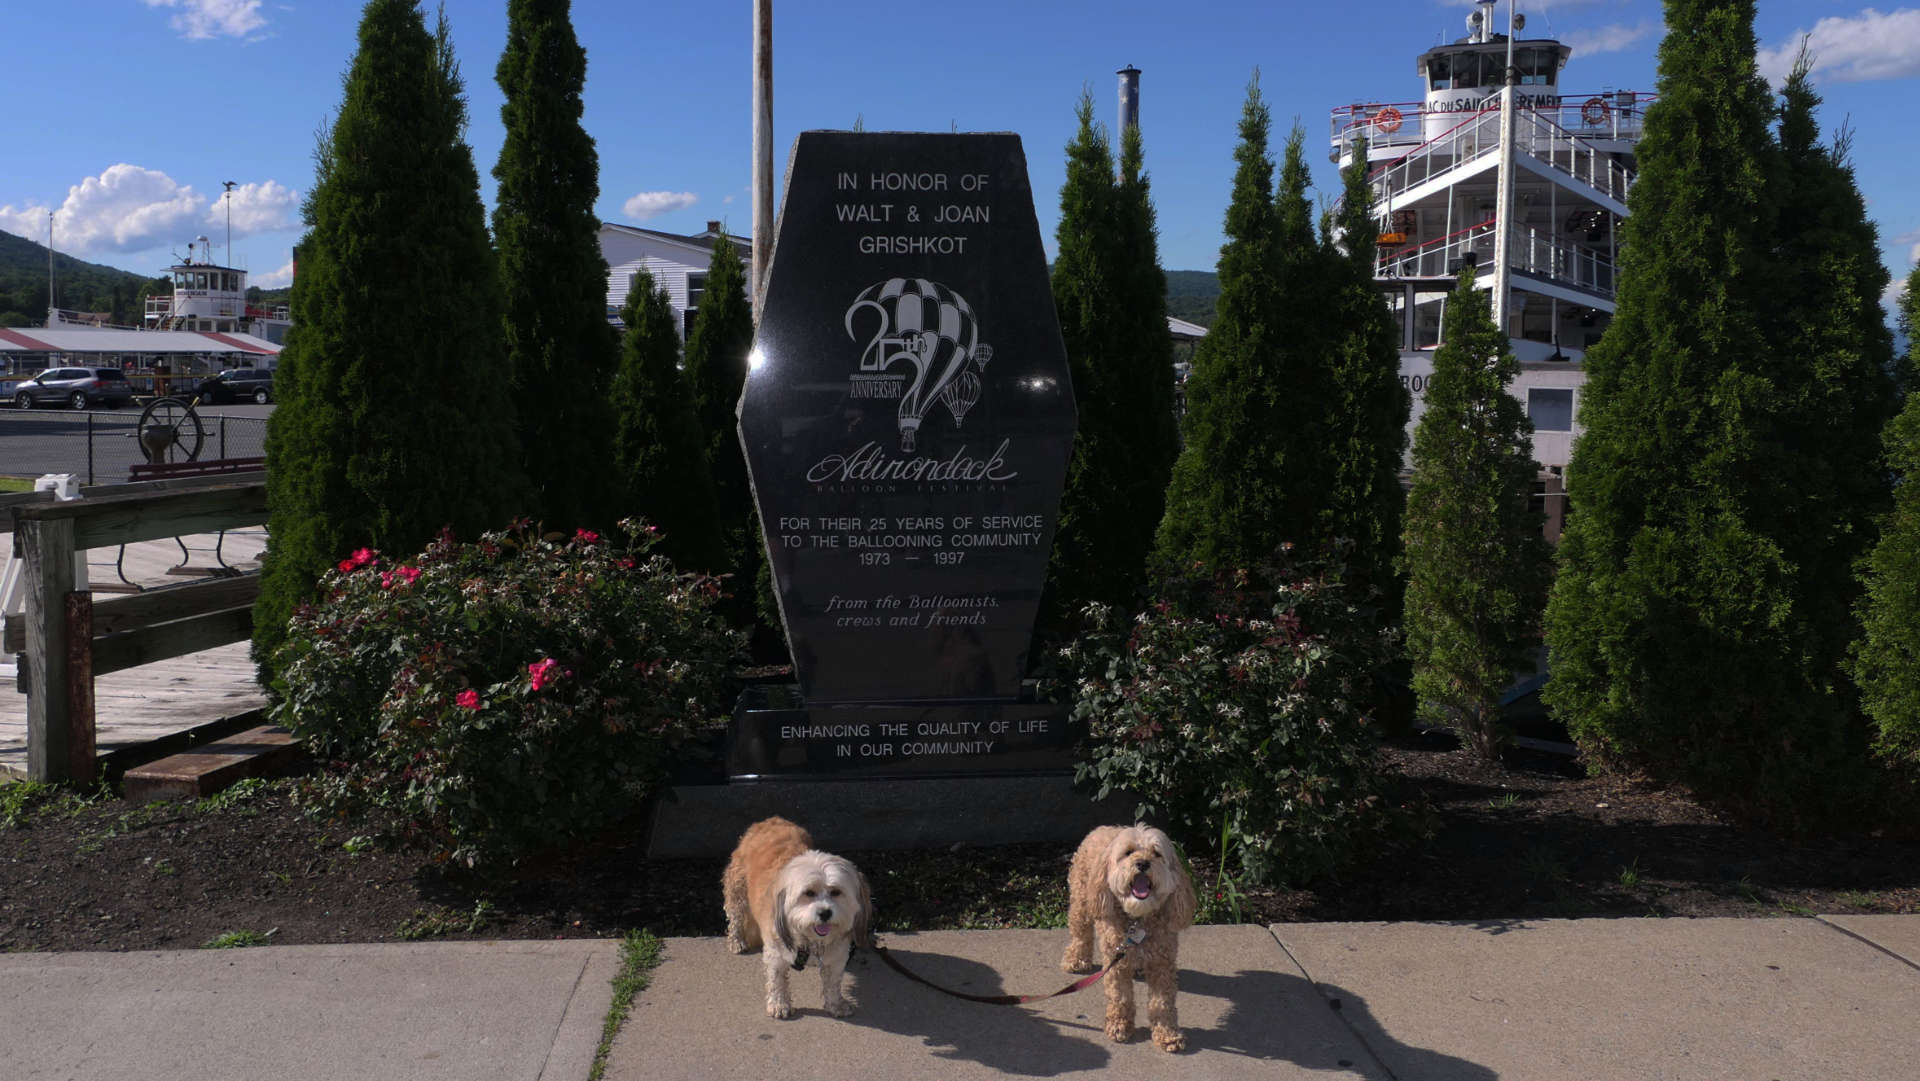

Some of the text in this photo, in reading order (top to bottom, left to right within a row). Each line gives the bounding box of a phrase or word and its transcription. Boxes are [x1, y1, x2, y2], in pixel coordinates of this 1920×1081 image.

[838, 172, 990, 192] IN HONOR OF
[835, 204, 990, 223] WALT & JOAN
[859, 236, 968, 255] GRISHKOT
[849, 381, 902, 399] ANNIVERSARY
[806, 438, 1018, 482] Adirondack
[780, 515, 1043, 530] FOR THEIR 25 YEARS OF SERVICE
[782, 532, 1042, 548] TO THE BALLOONING COMMUNITY
[859, 552, 891, 566] 1973
[934, 551, 965, 565] 1997
[824, 595, 868, 612] from
[875, 595, 901, 609] the
[836, 611, 987, 628] crews and friends
[781, 720, 1048, 738] ENHANCING THE QUALITY OF LIFE
[836, 741, 994, 757] IN OUR COMMUNITY
